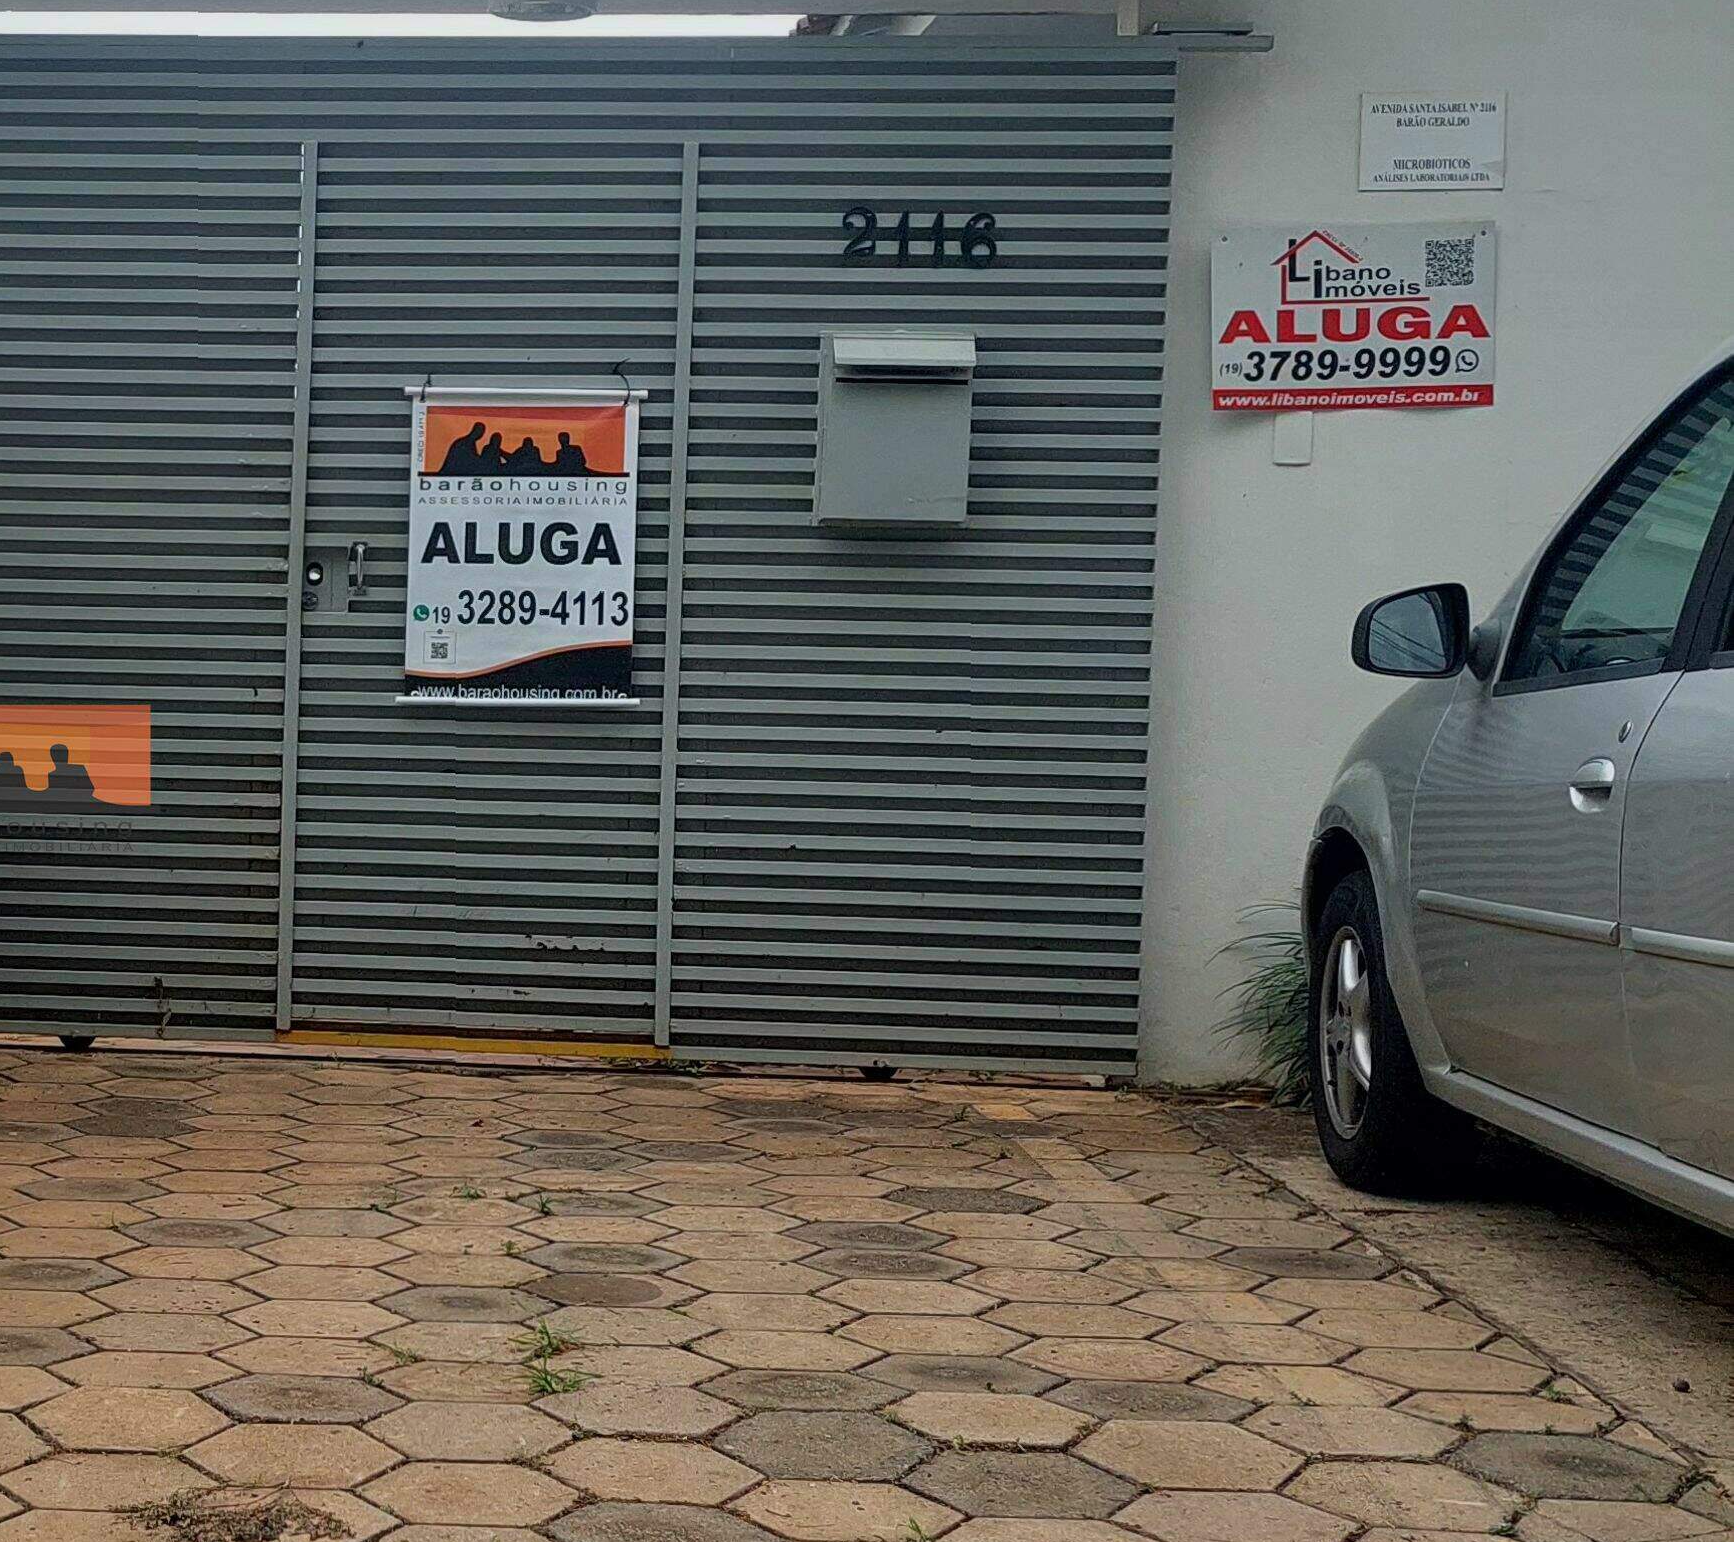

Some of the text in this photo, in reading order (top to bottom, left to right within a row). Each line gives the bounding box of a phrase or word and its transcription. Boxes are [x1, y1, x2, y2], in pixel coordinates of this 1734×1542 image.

[1370, 103, 1407, 114] AVENIDA
[1409, 103, 1436, 113] SANTA
[1437, 102, 1467, 113] ISABEL
[1396, 115, 1470, 127] BARÃO GERALDO
[842, 206, 997, 269] 2116
[1219, 304, 1491, 344] ALUGA
[1243, 345, 1452, 382] 3789-9999
[1219, 388, 1480, 407] www.libanoimoveis.com.br
[418, 495, 628, 506] ASSESSORIA IMOBILIÁRIA
[419, 478, 628, 495] barãohousing
[421, 521, 622, 565] ALUGA
[432, 589, 629, 626] 19 3289-4113
